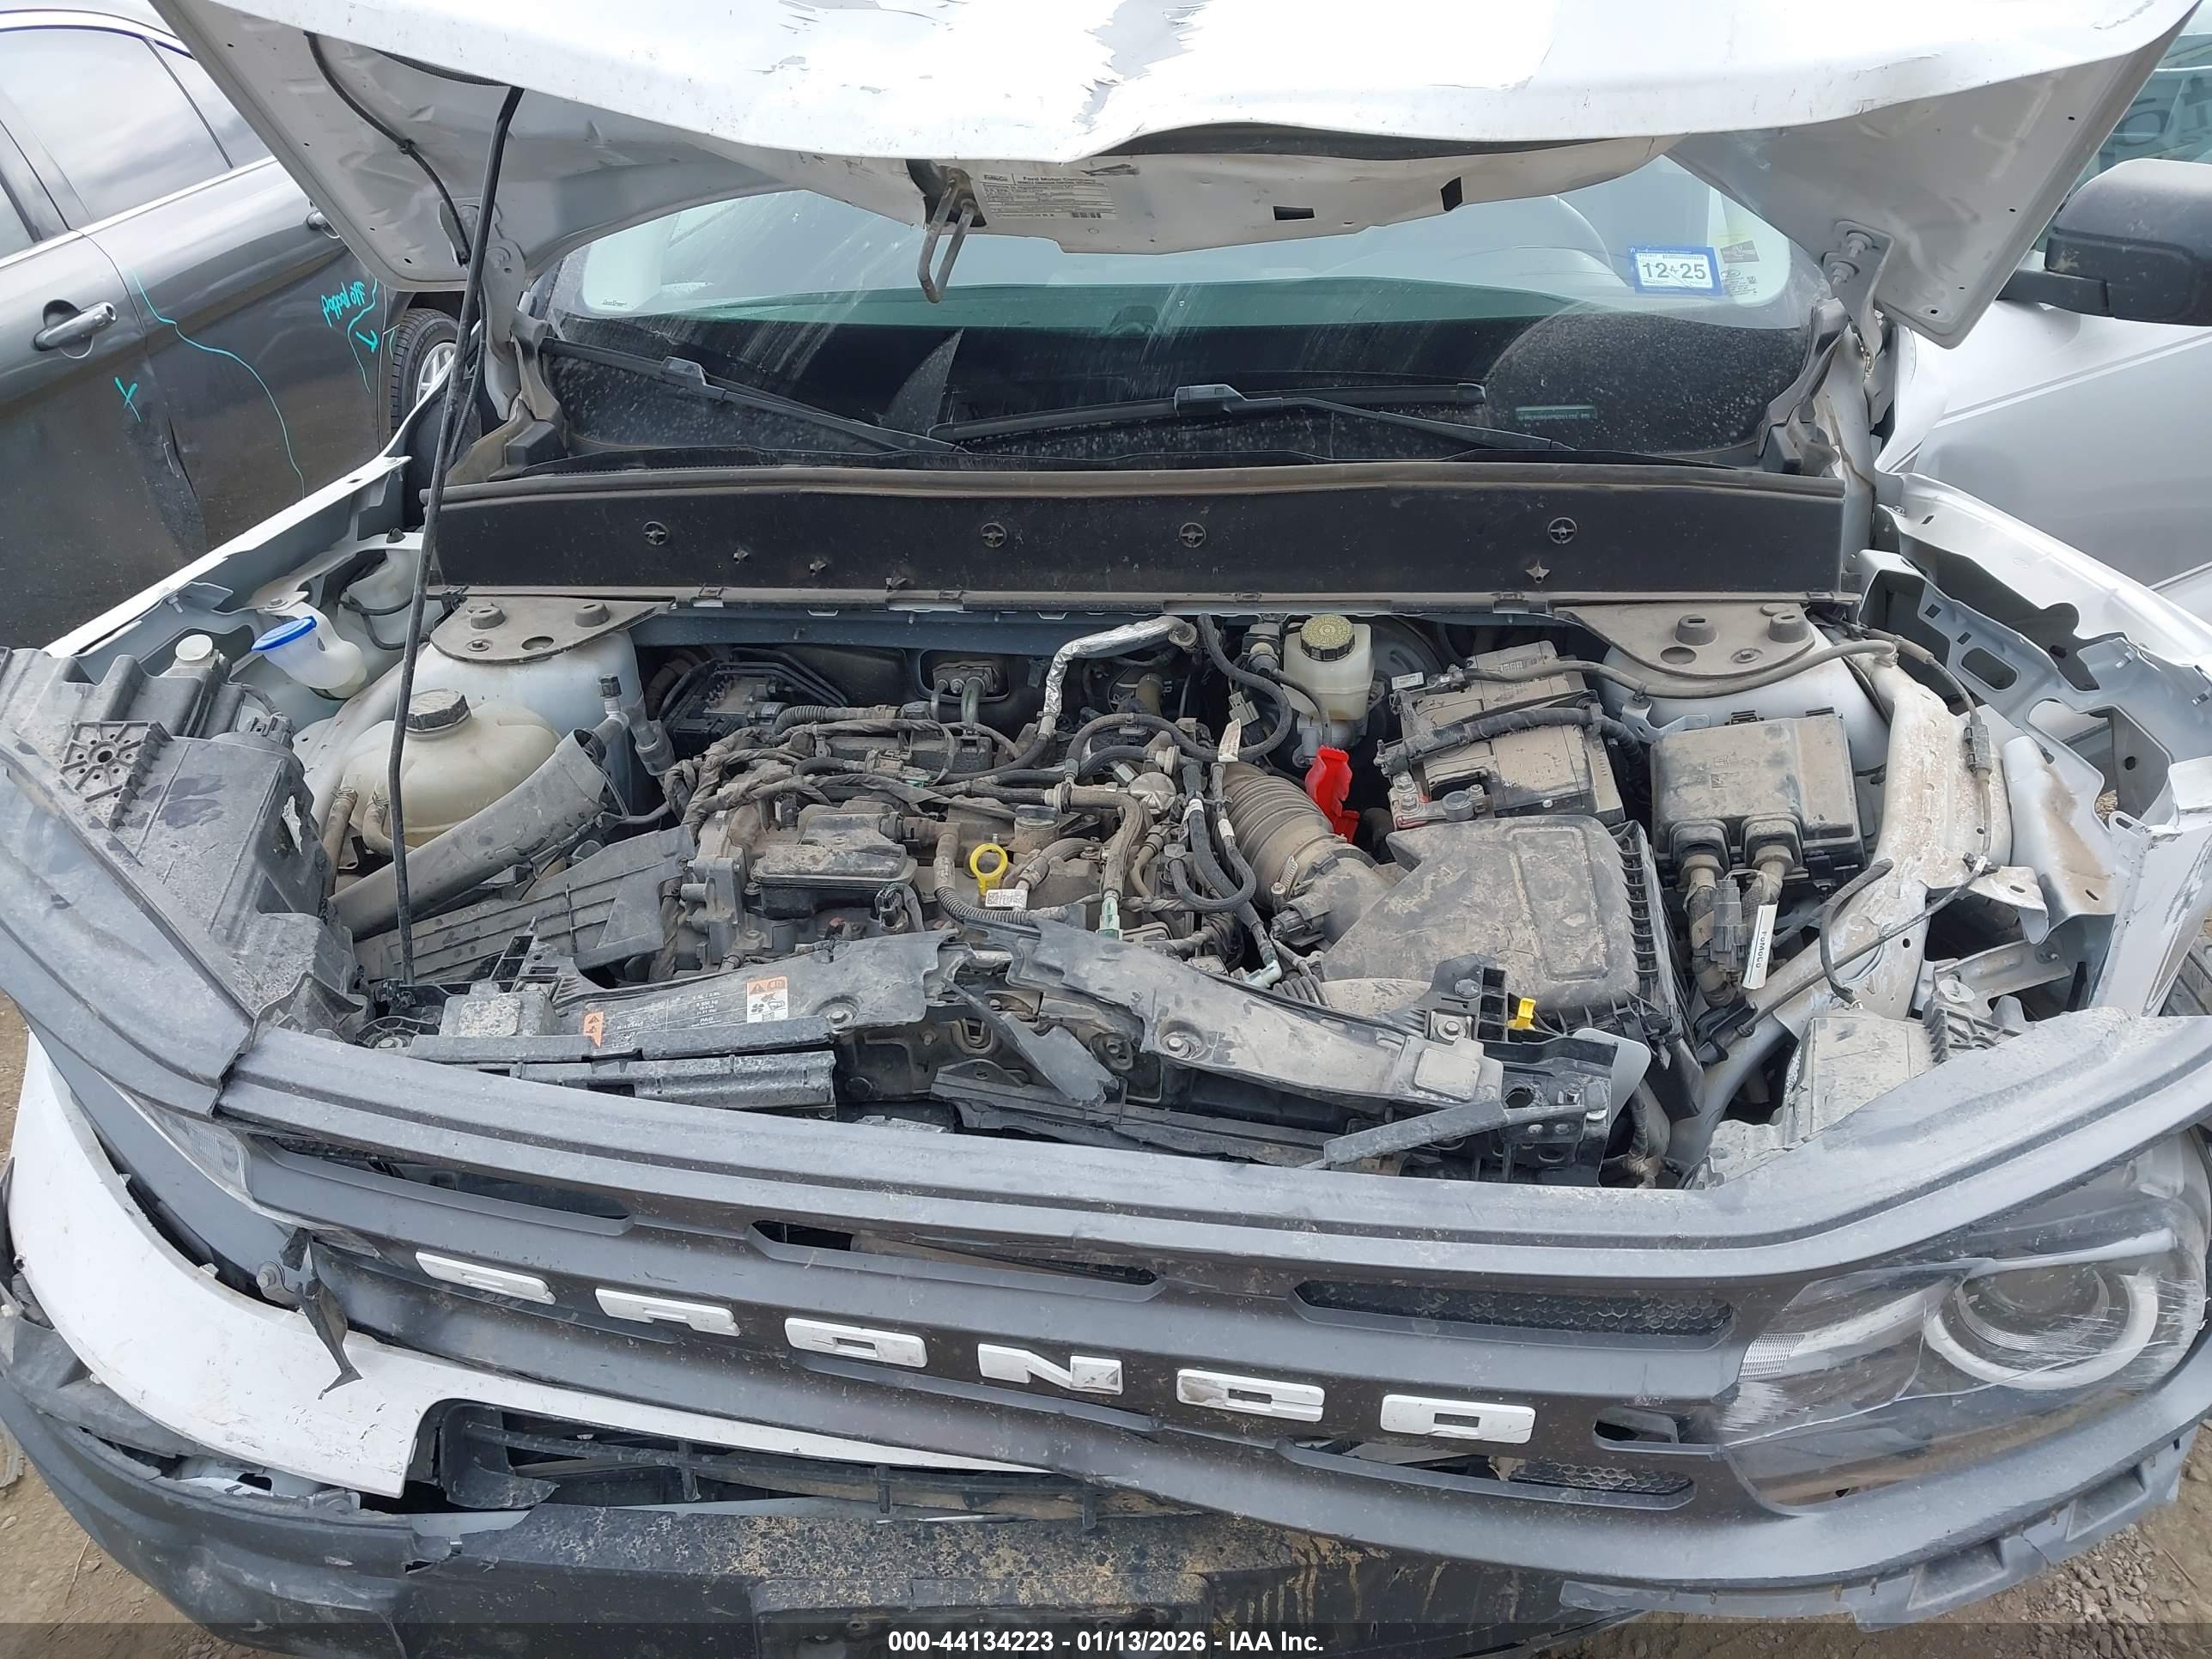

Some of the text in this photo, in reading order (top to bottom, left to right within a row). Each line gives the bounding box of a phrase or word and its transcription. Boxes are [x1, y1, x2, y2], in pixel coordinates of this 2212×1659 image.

[1643, 262, 1706, 279] 12 25
[415, 1252, 1536, 1443] BRONCO
